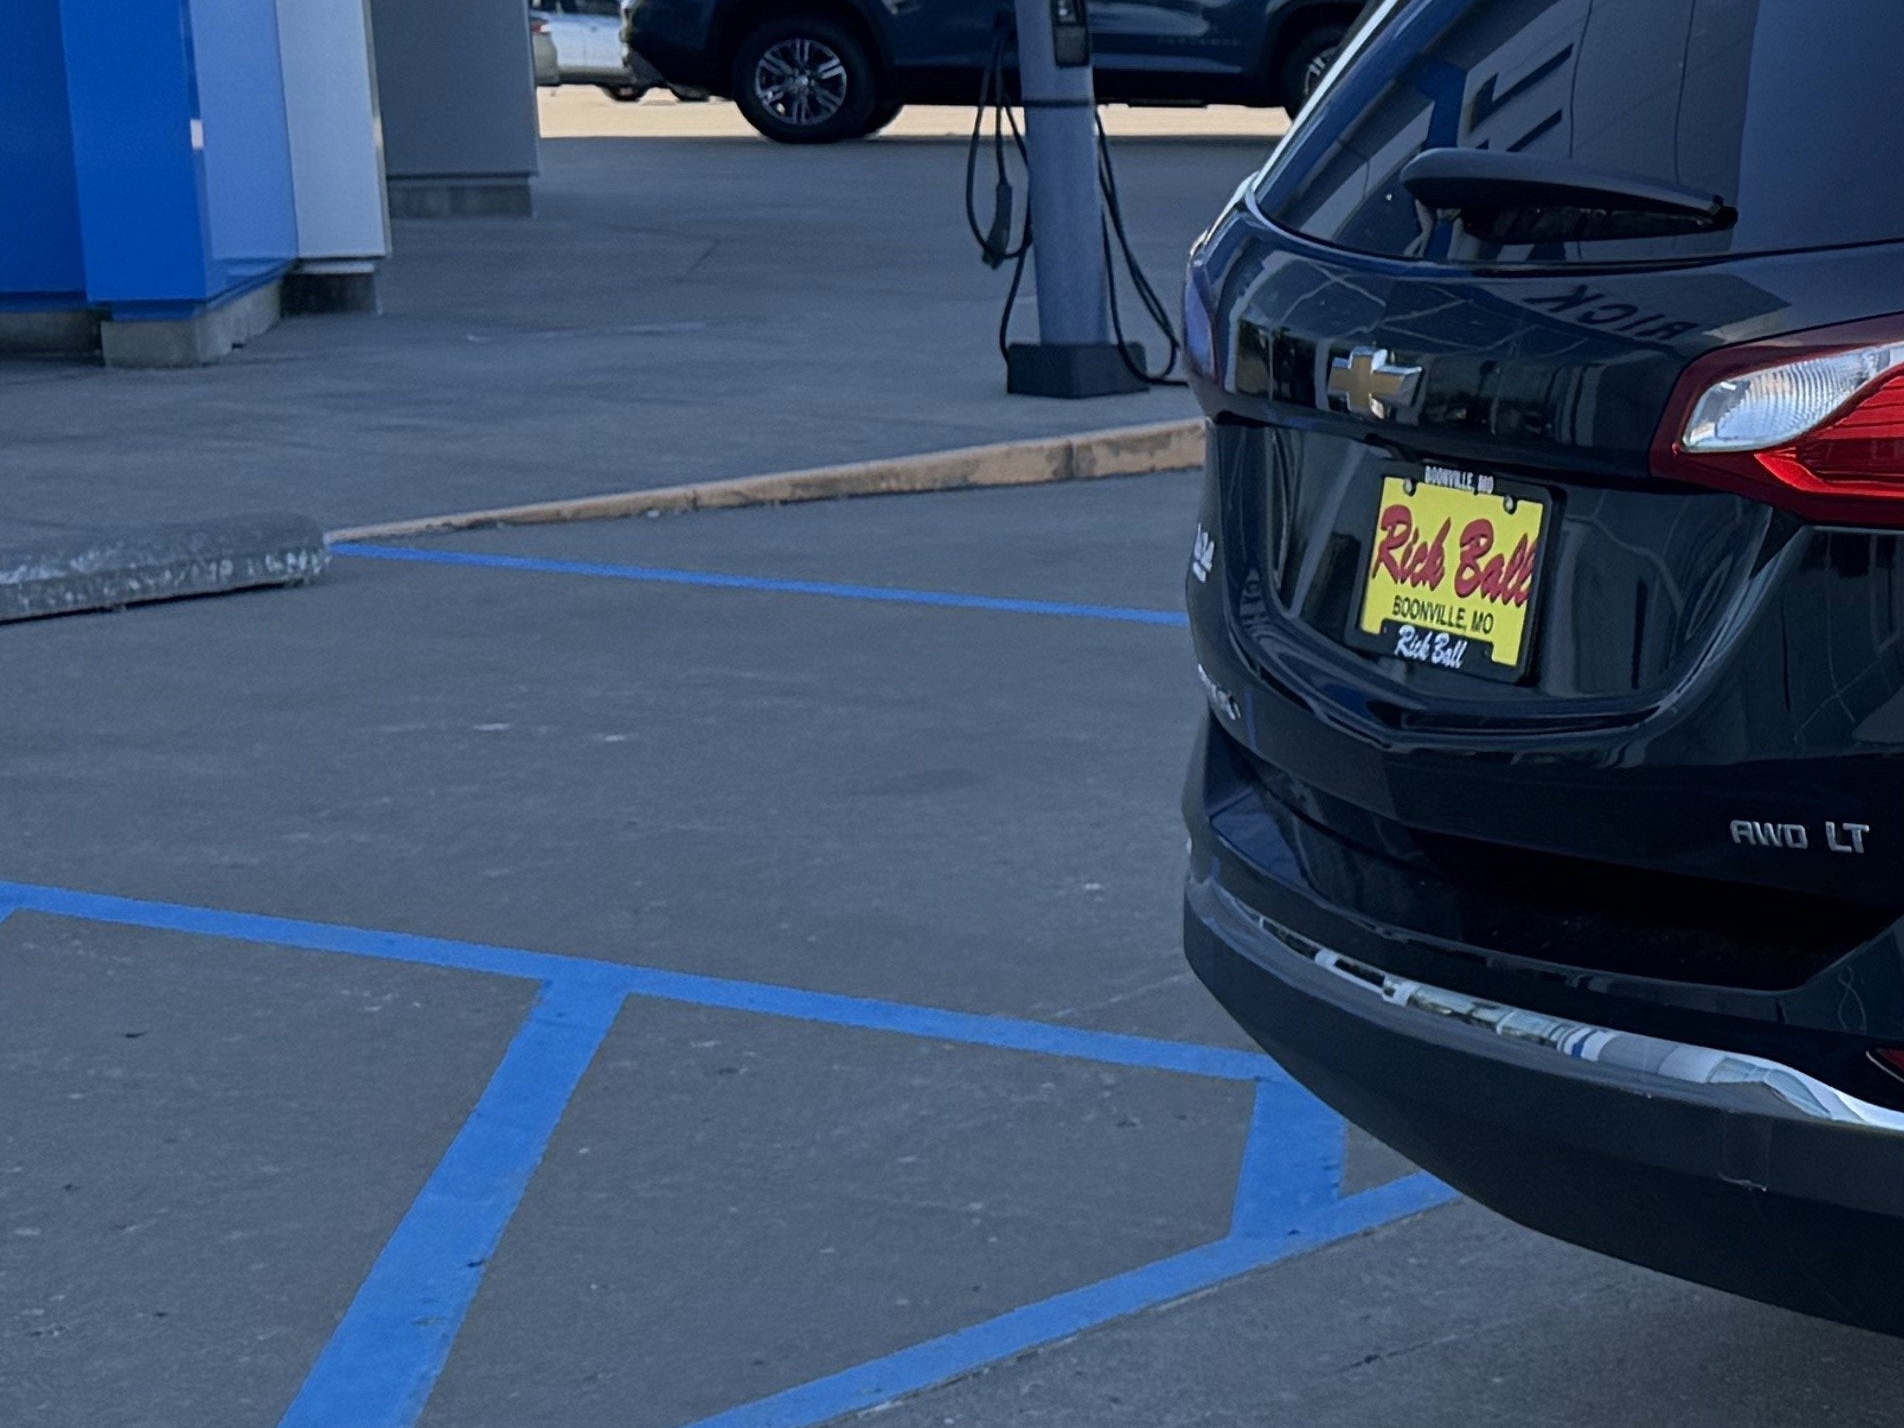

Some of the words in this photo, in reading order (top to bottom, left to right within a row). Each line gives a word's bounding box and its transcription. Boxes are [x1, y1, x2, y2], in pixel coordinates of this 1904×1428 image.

[1371, 504, 1452, 592] Rick
[1454, 518, 1537, 608] Ball
[1392, 594, 1467, 632] BOONVILLE,
[1470, 609, 1494, 635] MO
[1394, 624, 1434, 663] Rick
[1431, 632, 1468, 669] Ball
[1730, 819, 1808, 849] AWD
[1825, 821, 1870, 854] LT
